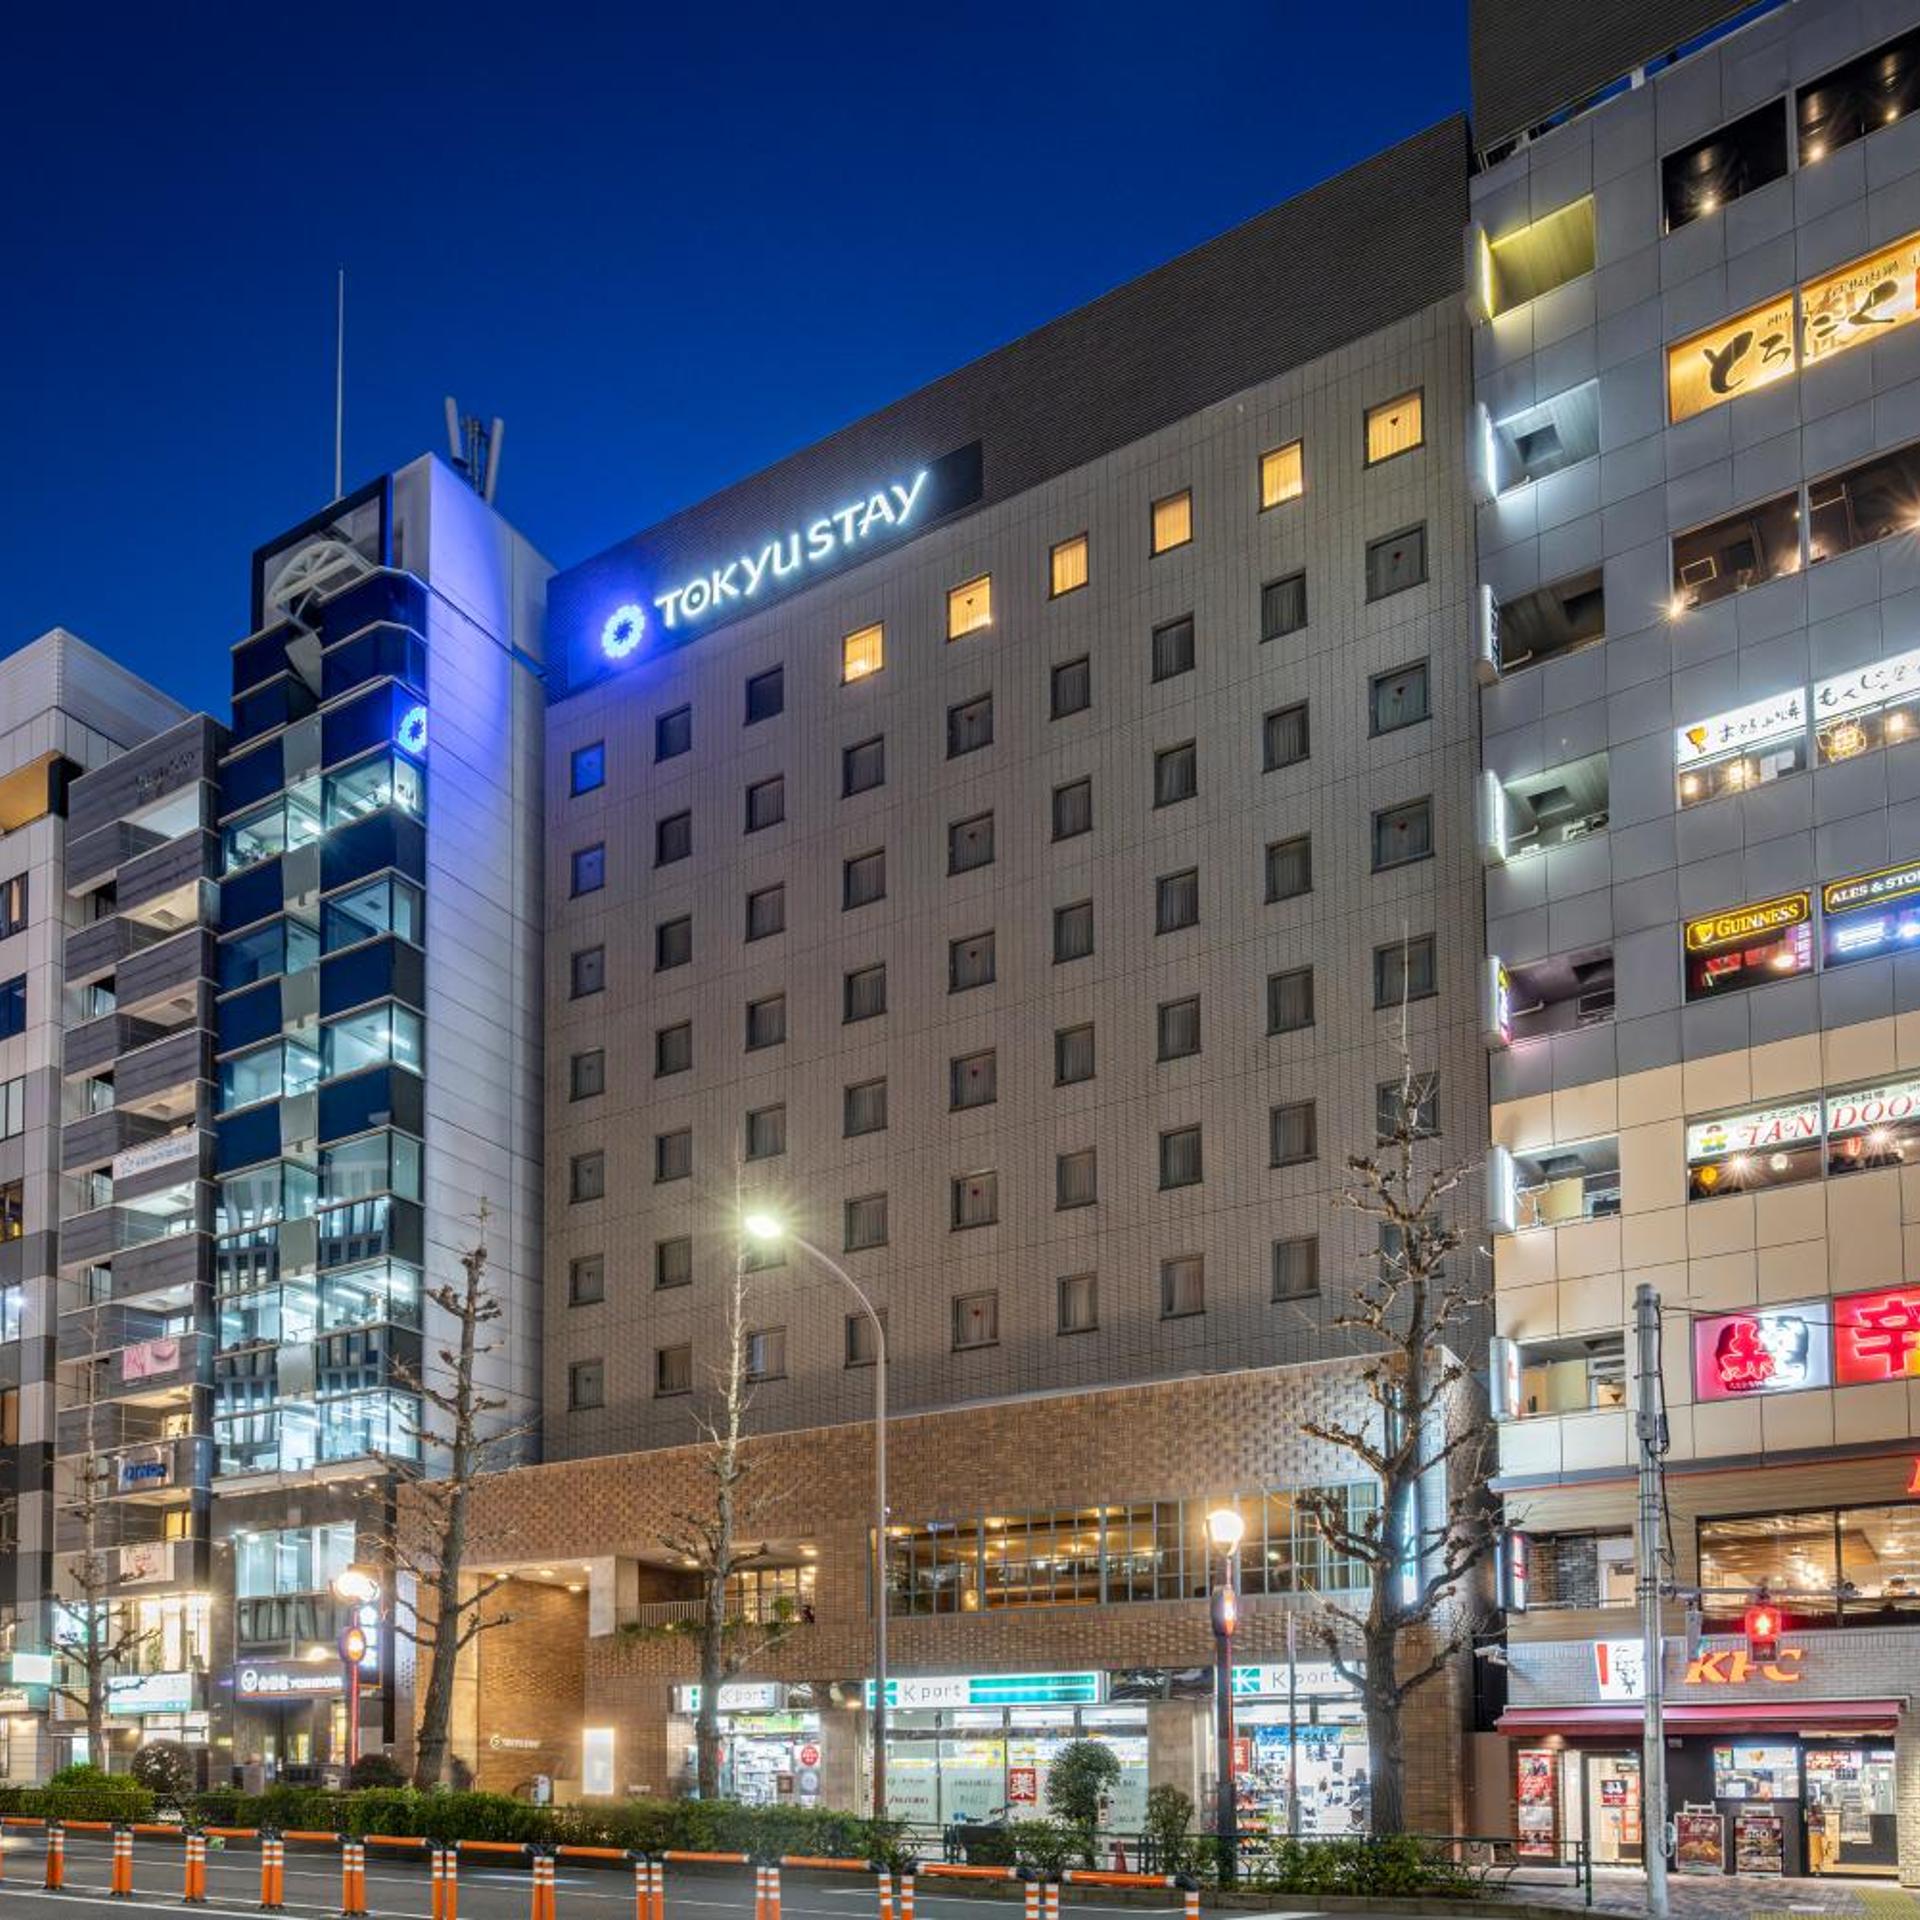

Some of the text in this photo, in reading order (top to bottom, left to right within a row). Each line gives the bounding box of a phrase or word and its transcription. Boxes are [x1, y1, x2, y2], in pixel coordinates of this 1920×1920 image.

[653, 471, 928, 629] TOKYU STAY
[1831, 885, 1868, 905] ALES
[1871, 882, 1884, 893] &
[1716, 903, 1799, 938] GUINNESS
[1832, 1094, 1920, 1131] DOO
